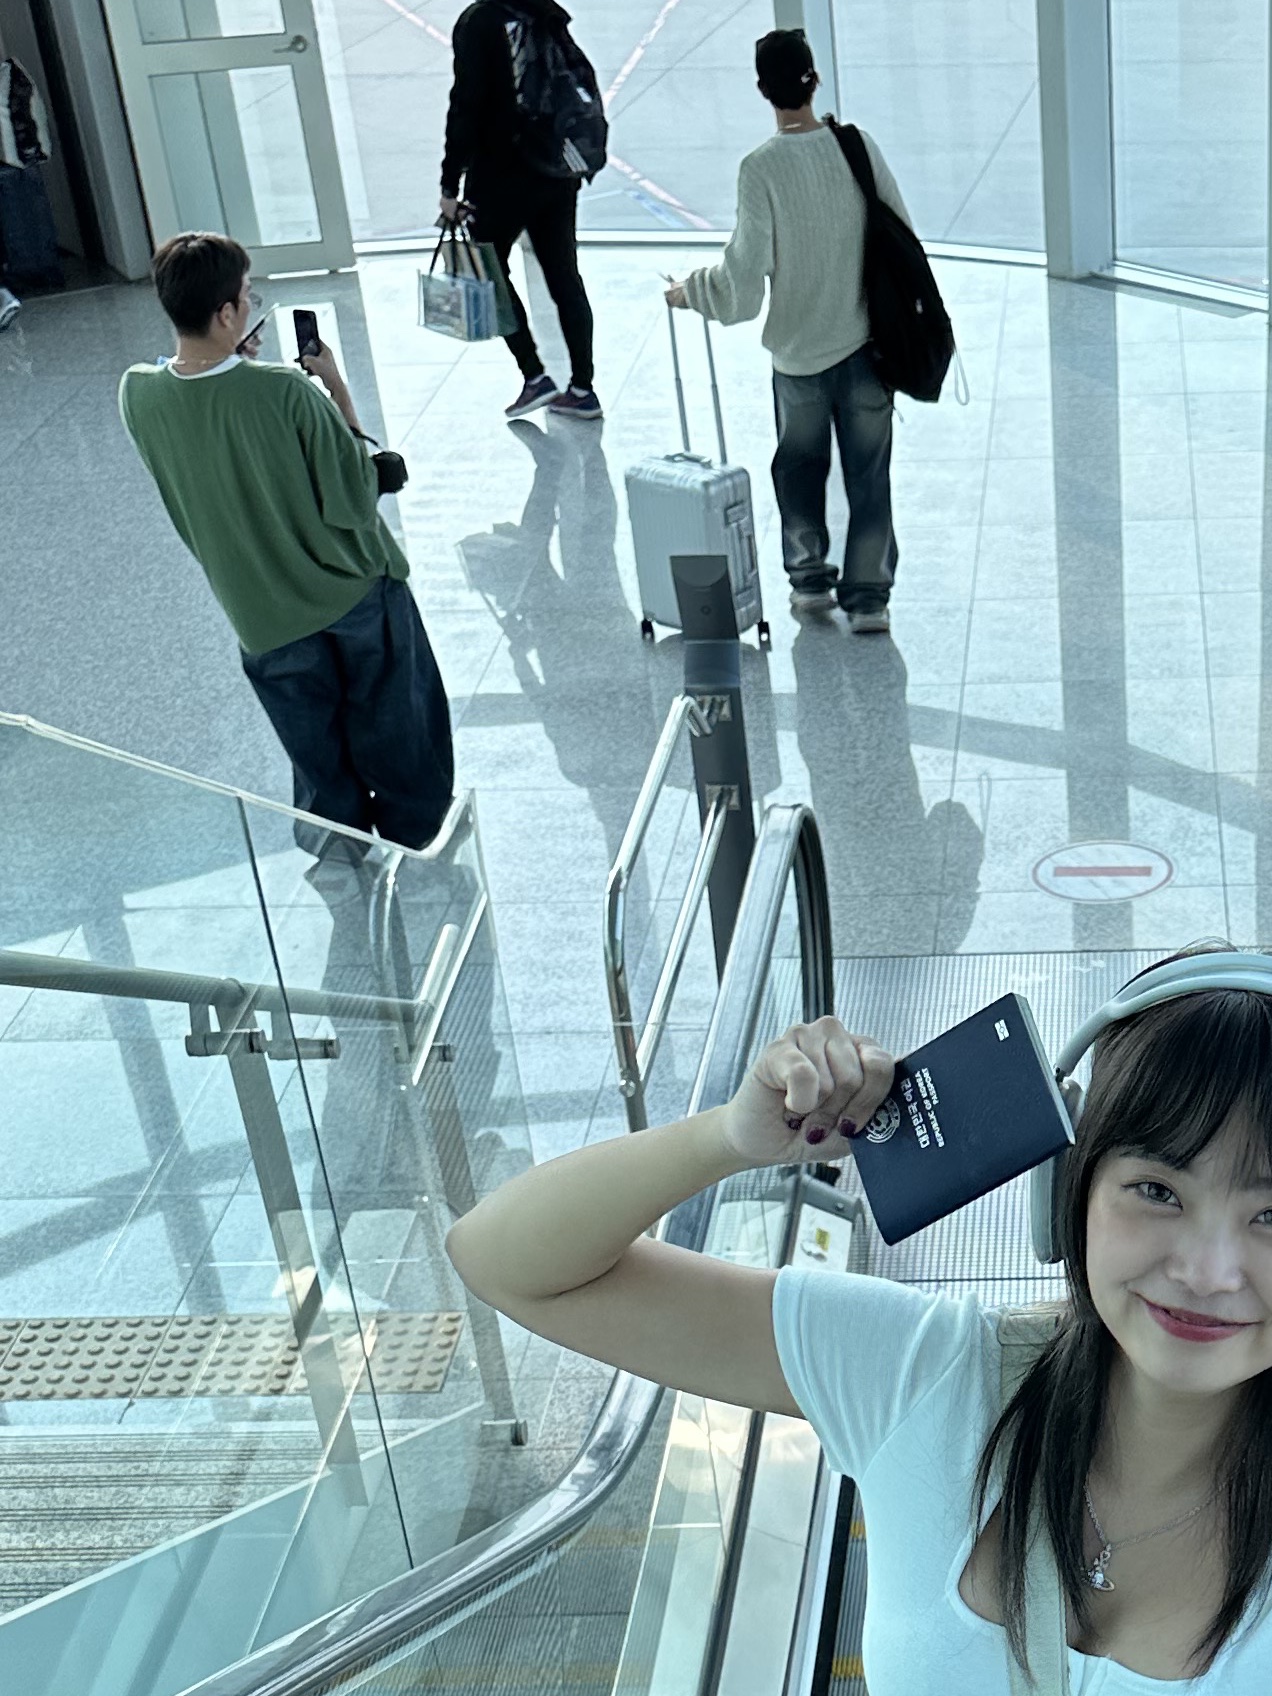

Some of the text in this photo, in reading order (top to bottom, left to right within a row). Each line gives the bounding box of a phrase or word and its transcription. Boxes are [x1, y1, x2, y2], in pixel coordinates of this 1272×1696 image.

[914, 1070, 928, 1098] KOREA
[921, 1067, 939, 1105] PASSPORT
[900, 1077, 930, 1149] 대한민국 여권
[927, 1110, 945, 1148] REPUBLIC
